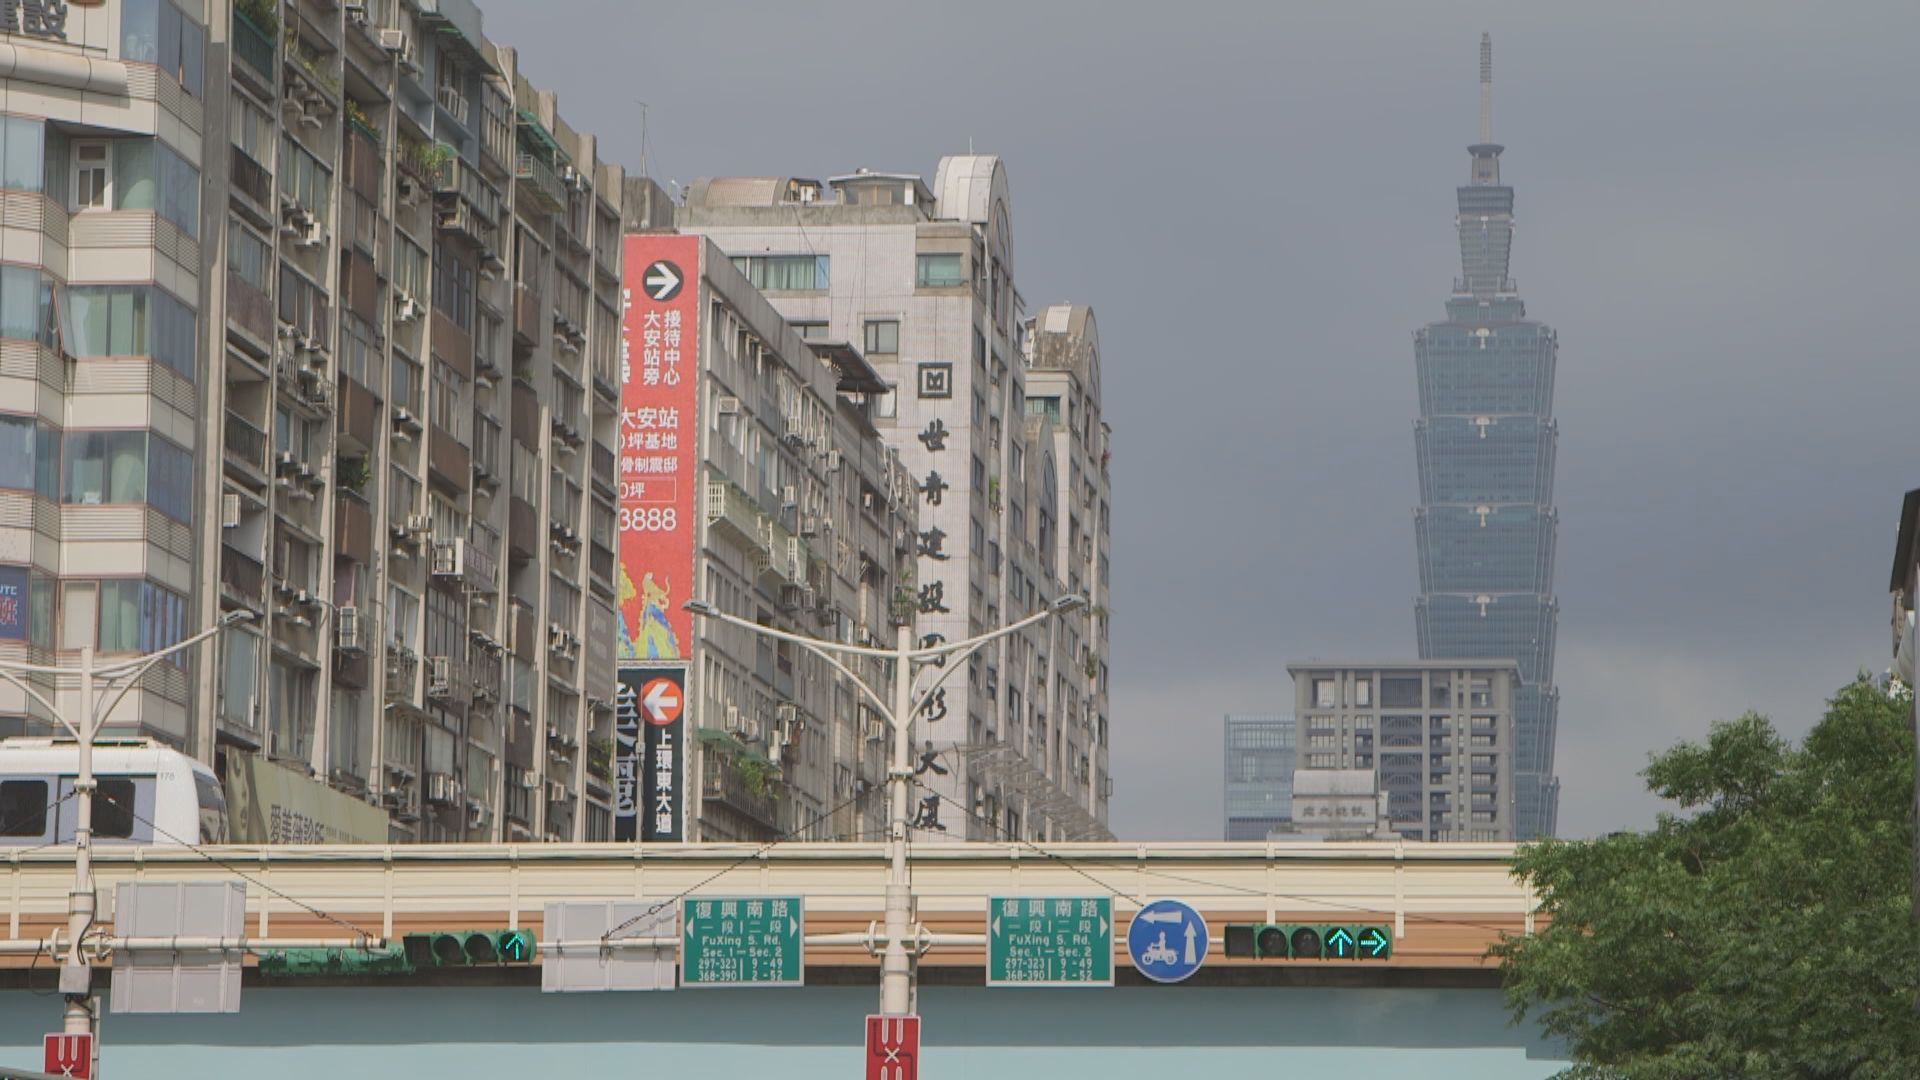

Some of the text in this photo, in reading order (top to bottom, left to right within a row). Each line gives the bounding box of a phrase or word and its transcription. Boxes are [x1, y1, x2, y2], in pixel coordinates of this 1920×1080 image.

[643, 309, 660, 385] 大安站旁
[664, 309, 681, 385] 接待中心
[621, 406, 678, 429] 大安站
[619, 507, 677, 531] 3888
[696, 900, 788, 919] 復興南路
[1002, 899, 1098, 917] 復興南路
[748, 935, 758, 945] S.
[764, 935, 781, 945] Rd.
[1056, 934, 1066, 944] S.
[1073, 934, 1090, 944] Rd.
[703, 948, 725, 957] Sec.
[749, 947, 771, 957] Sec.
[775, 947, 782, 957] 2
[1010, 946, 1033, 957] Sec.
[1057, 946, 1080, 957] Sec.
[1084, 946, 1092, 957] 2
[699, 958, 737, 969] 297-323
[1005, 958, 1045, 969] 297-323
